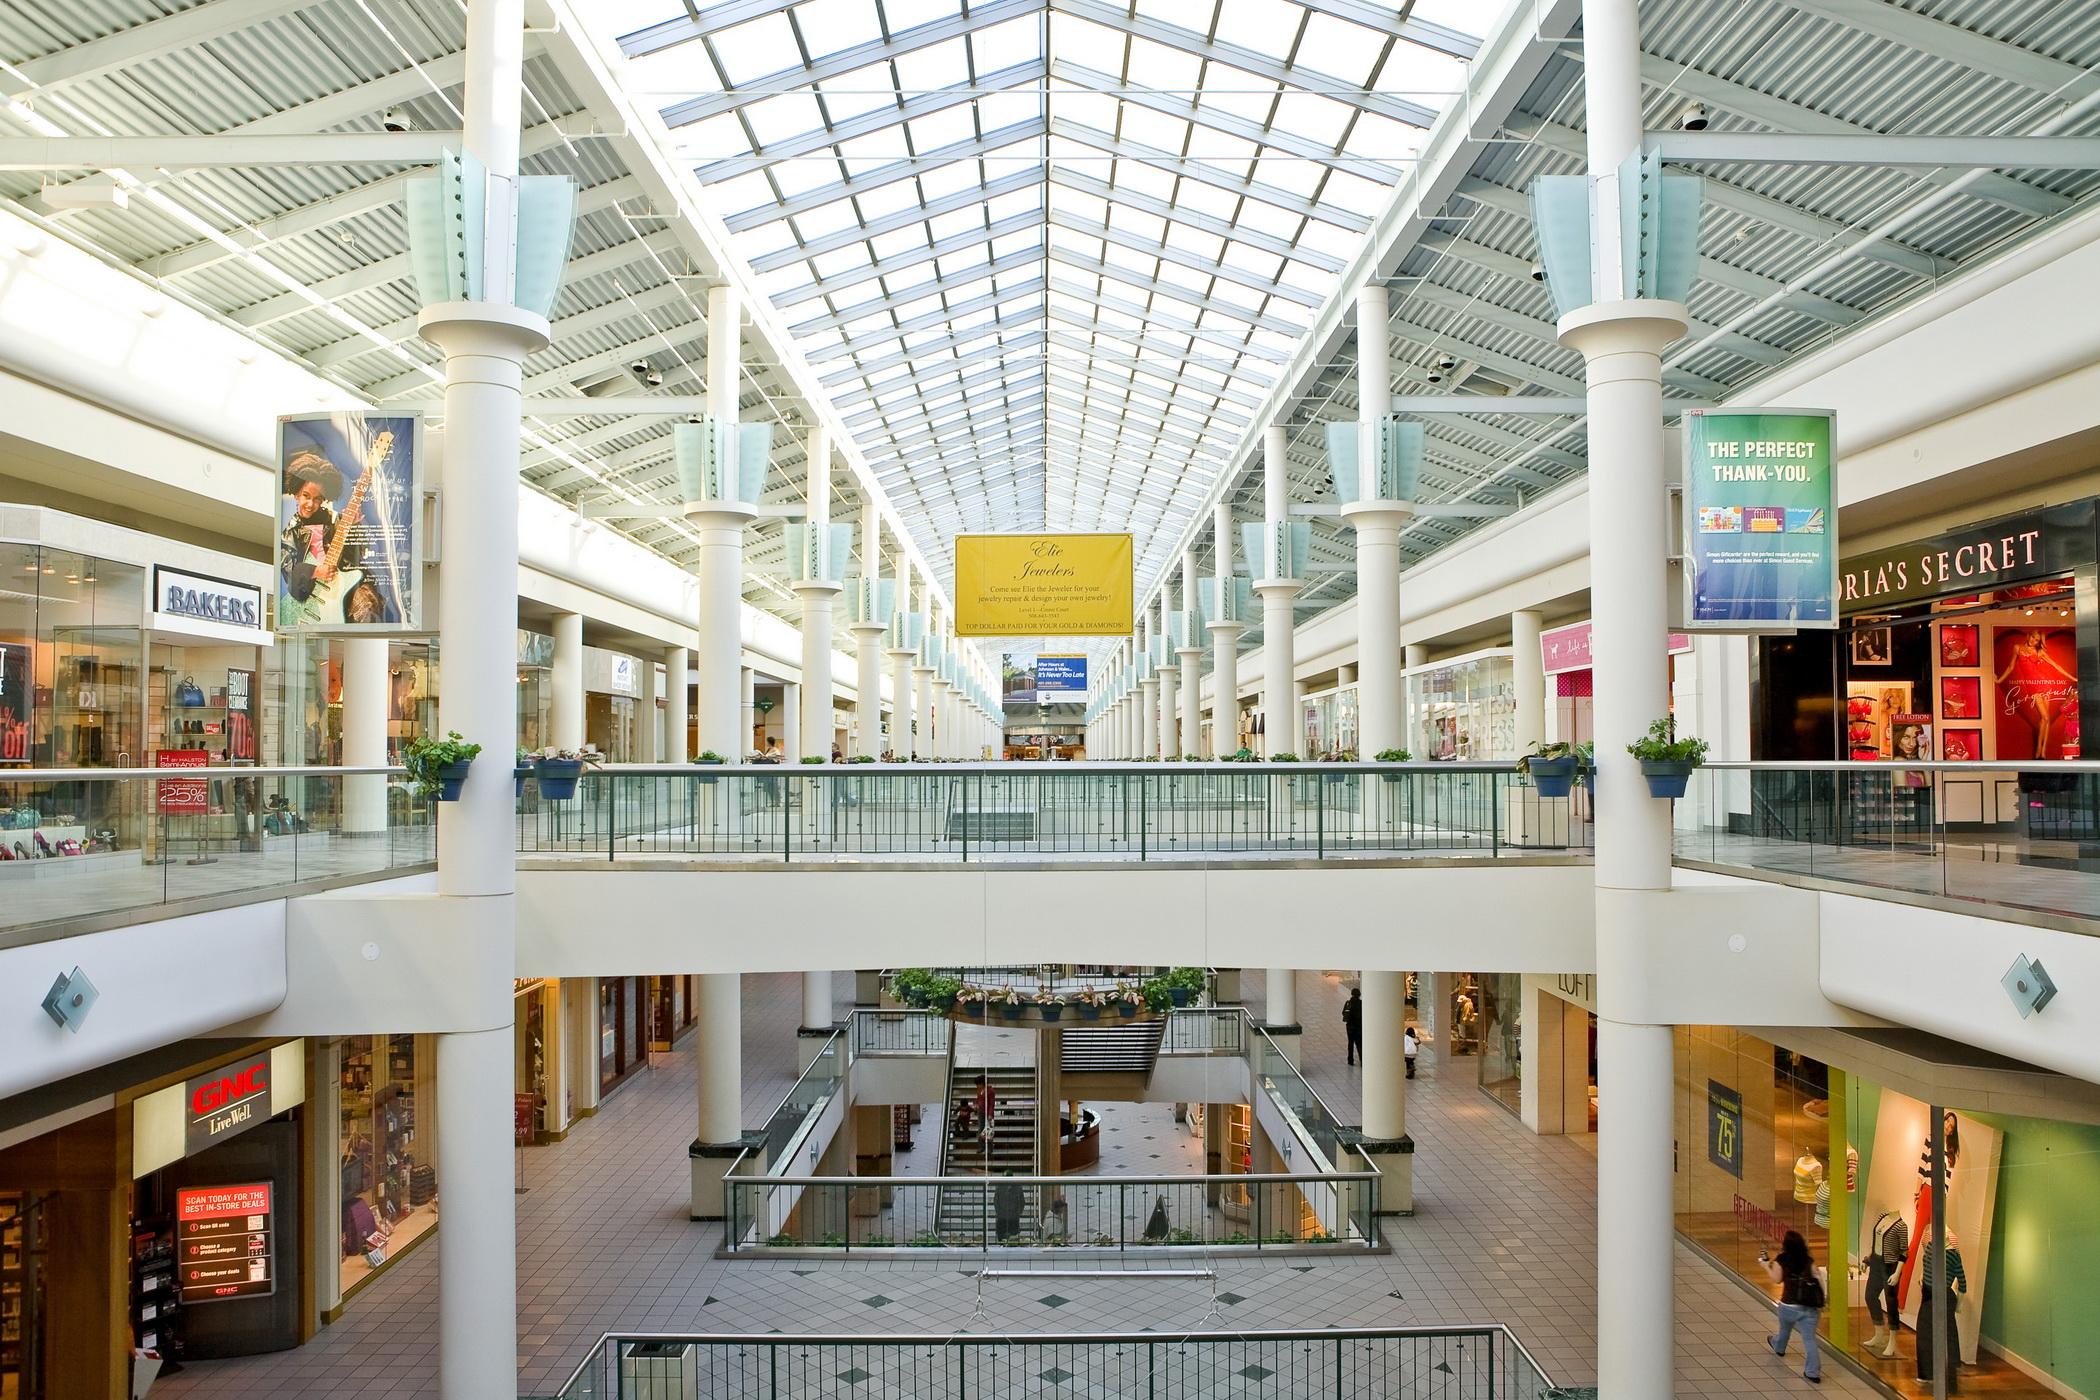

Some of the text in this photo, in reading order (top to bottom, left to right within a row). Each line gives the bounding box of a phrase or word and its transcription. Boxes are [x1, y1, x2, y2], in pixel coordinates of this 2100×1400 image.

[1707, 441, 1816, 458] THE PERFECT
[1712, 465, 1812, 482] THANK-YOU.
[1030, 541, 1064, 558] Elie
[1921, 530, 2039, 586] SECRET
[1013, 560, 1075, 580] Jewelers
[168, 585, 256, 624] BAKERS
[978, 595, 1001, 603] jewelry
[1003, 595, 1022, 603] repair
[1031, 594, 1052, 602] design
[1084, 594, 1112, 602] jewelry!
[160, 787, 204, 803] 25%
[1559, 973, 1592, 1001] LOFT
[192, 1062, 268, 1115] GNC
[210, 1117, 231, 1135] Live
[185, 1192, 264, 1205] SCAN TODAY FOR THE
[185, 1200, 265, 1213] BEST IN-STORE DEALS
[215, 1286, 238, 1294] GNC
